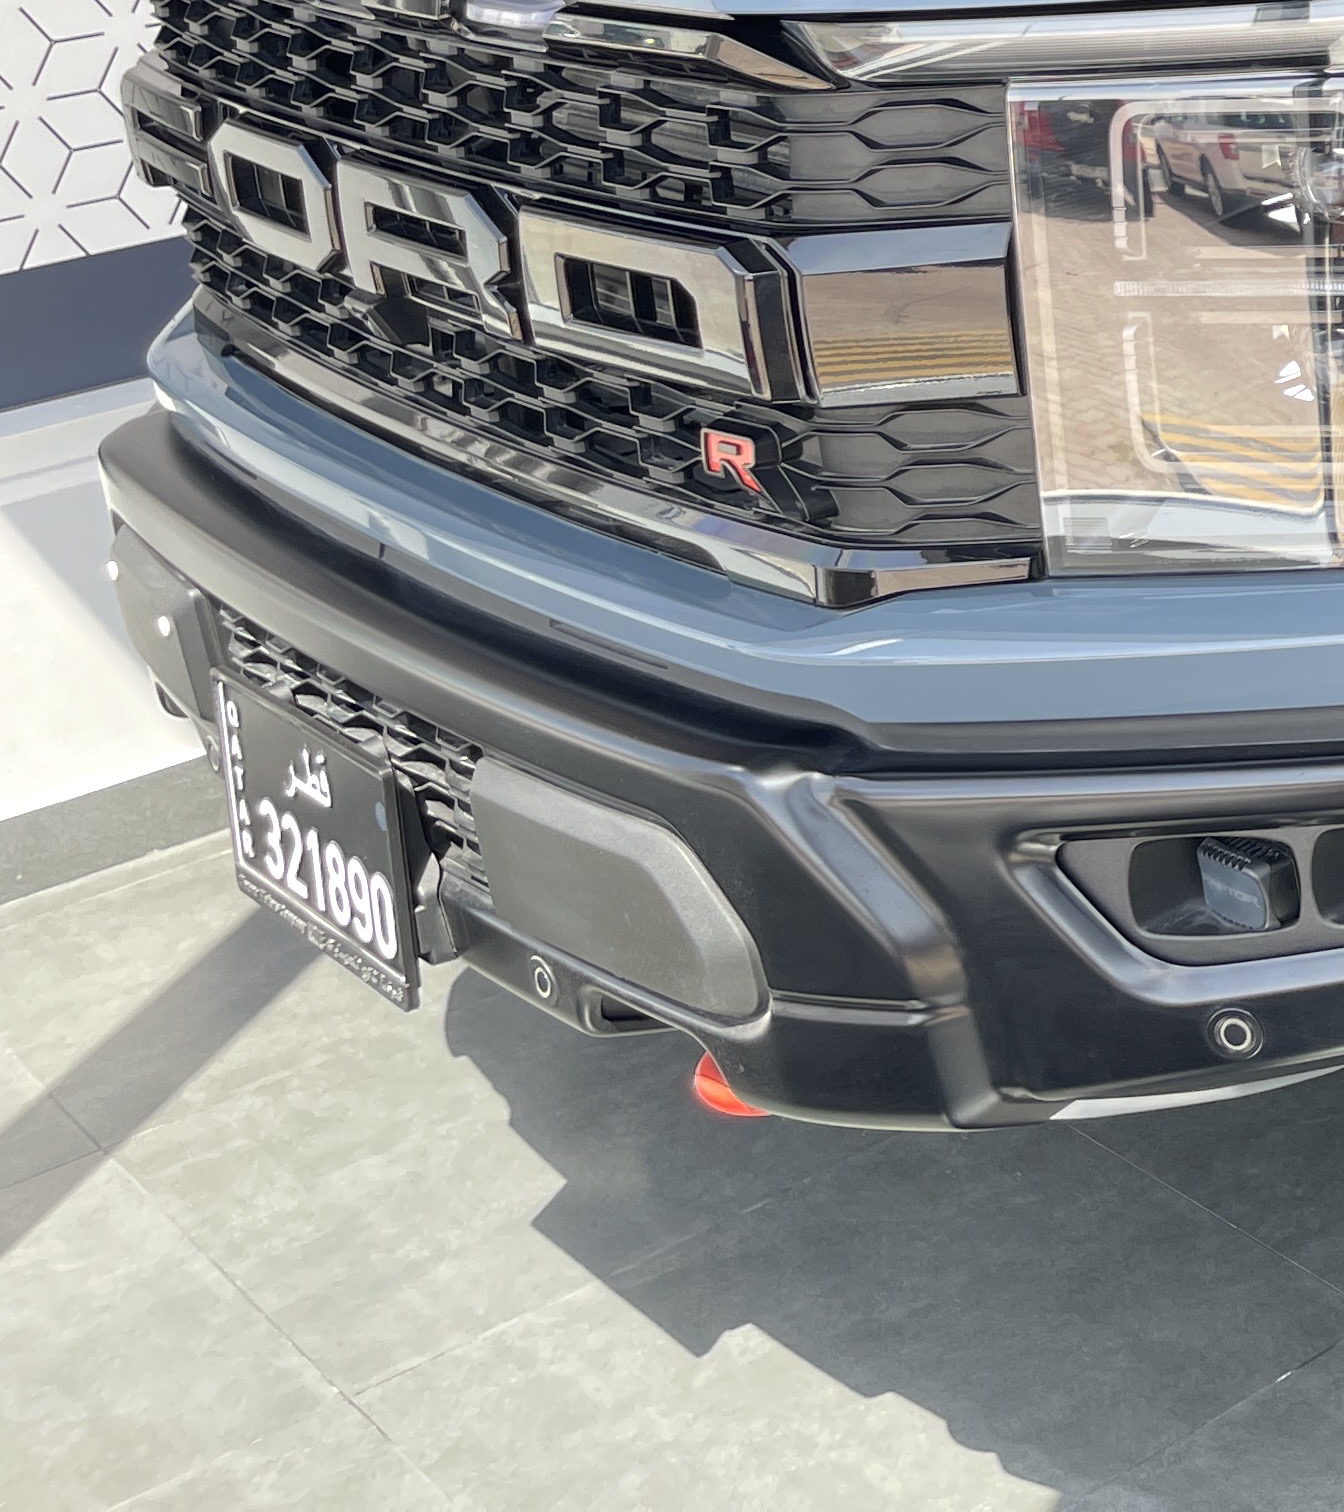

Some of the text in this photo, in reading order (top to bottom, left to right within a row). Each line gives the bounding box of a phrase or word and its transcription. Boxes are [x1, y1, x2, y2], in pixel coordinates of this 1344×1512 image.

[700, 427, 768, 496] R
[283, 742, 332, 809] قطر
[257, 796, 399, 960] 321890
